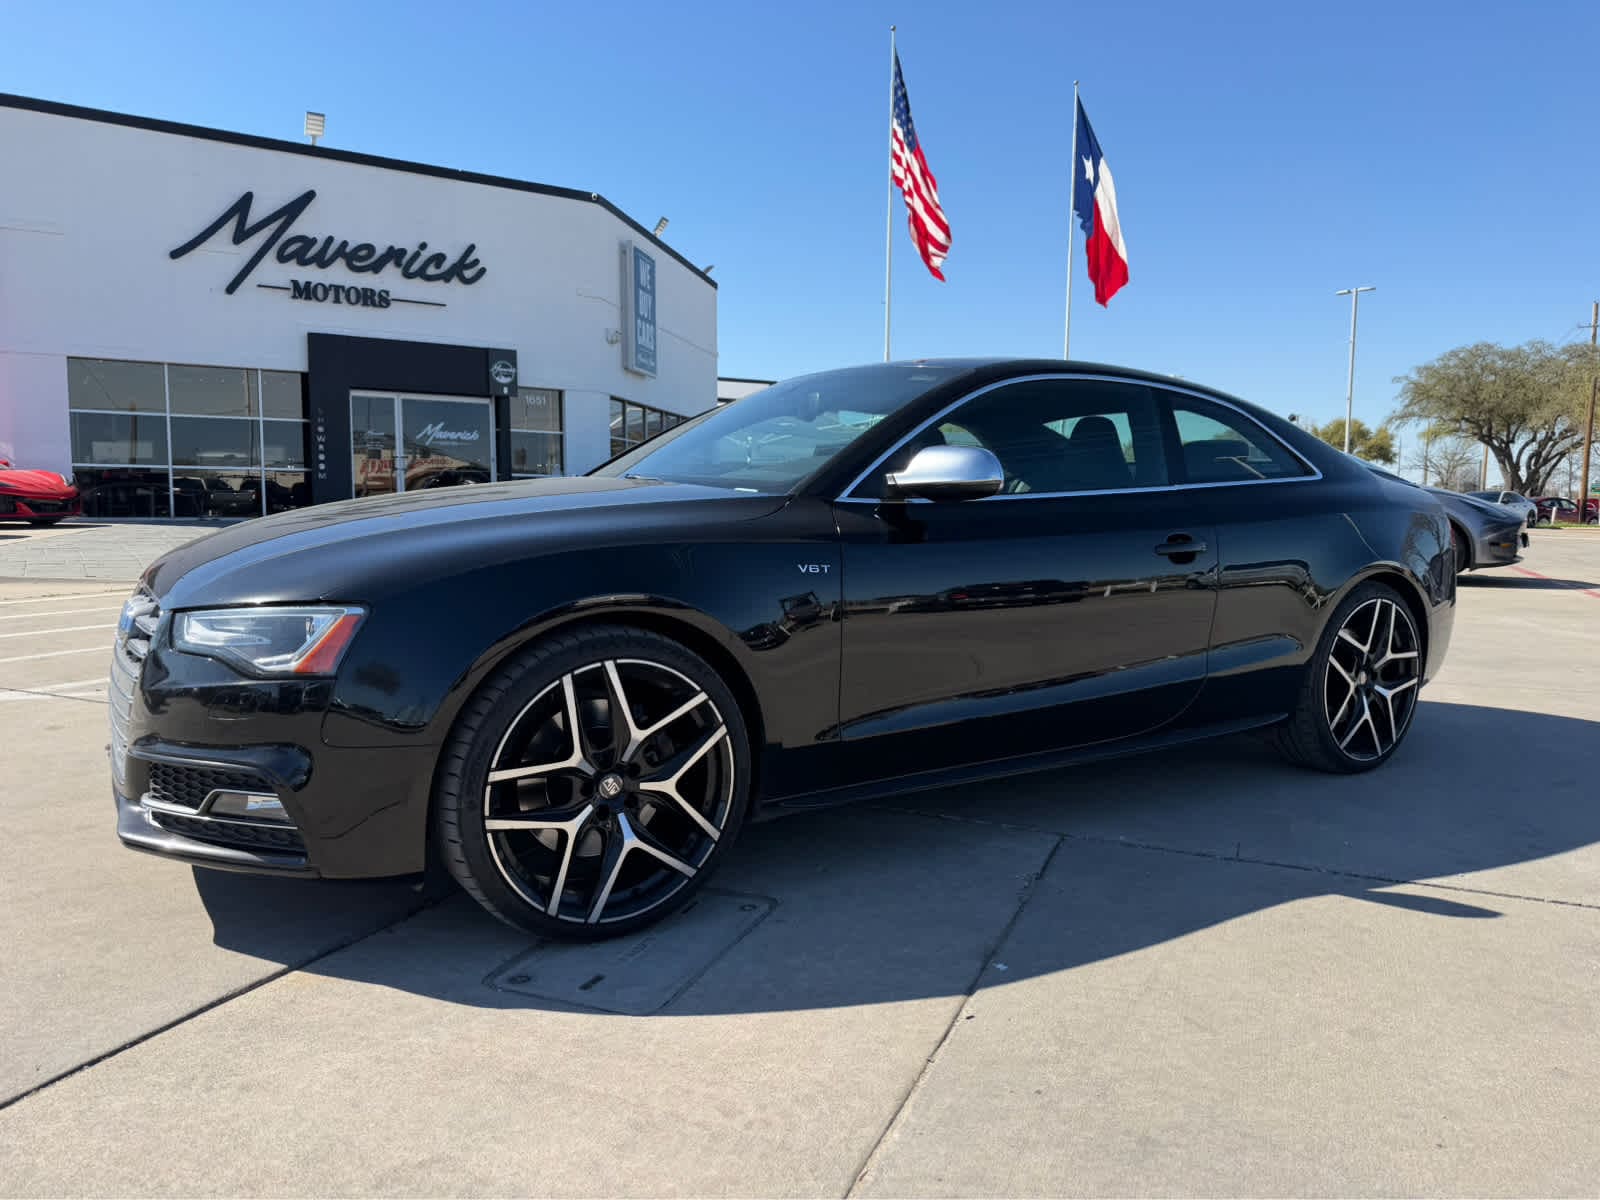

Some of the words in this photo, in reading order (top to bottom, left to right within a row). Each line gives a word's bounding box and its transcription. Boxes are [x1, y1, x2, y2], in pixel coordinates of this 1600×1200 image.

[169, 189, 487, 295] Maverick
[290, 280, 391, 308] MOTORS
[415, 421, 480, 446] Maverick
[798, 564, 830, 573] V6T
